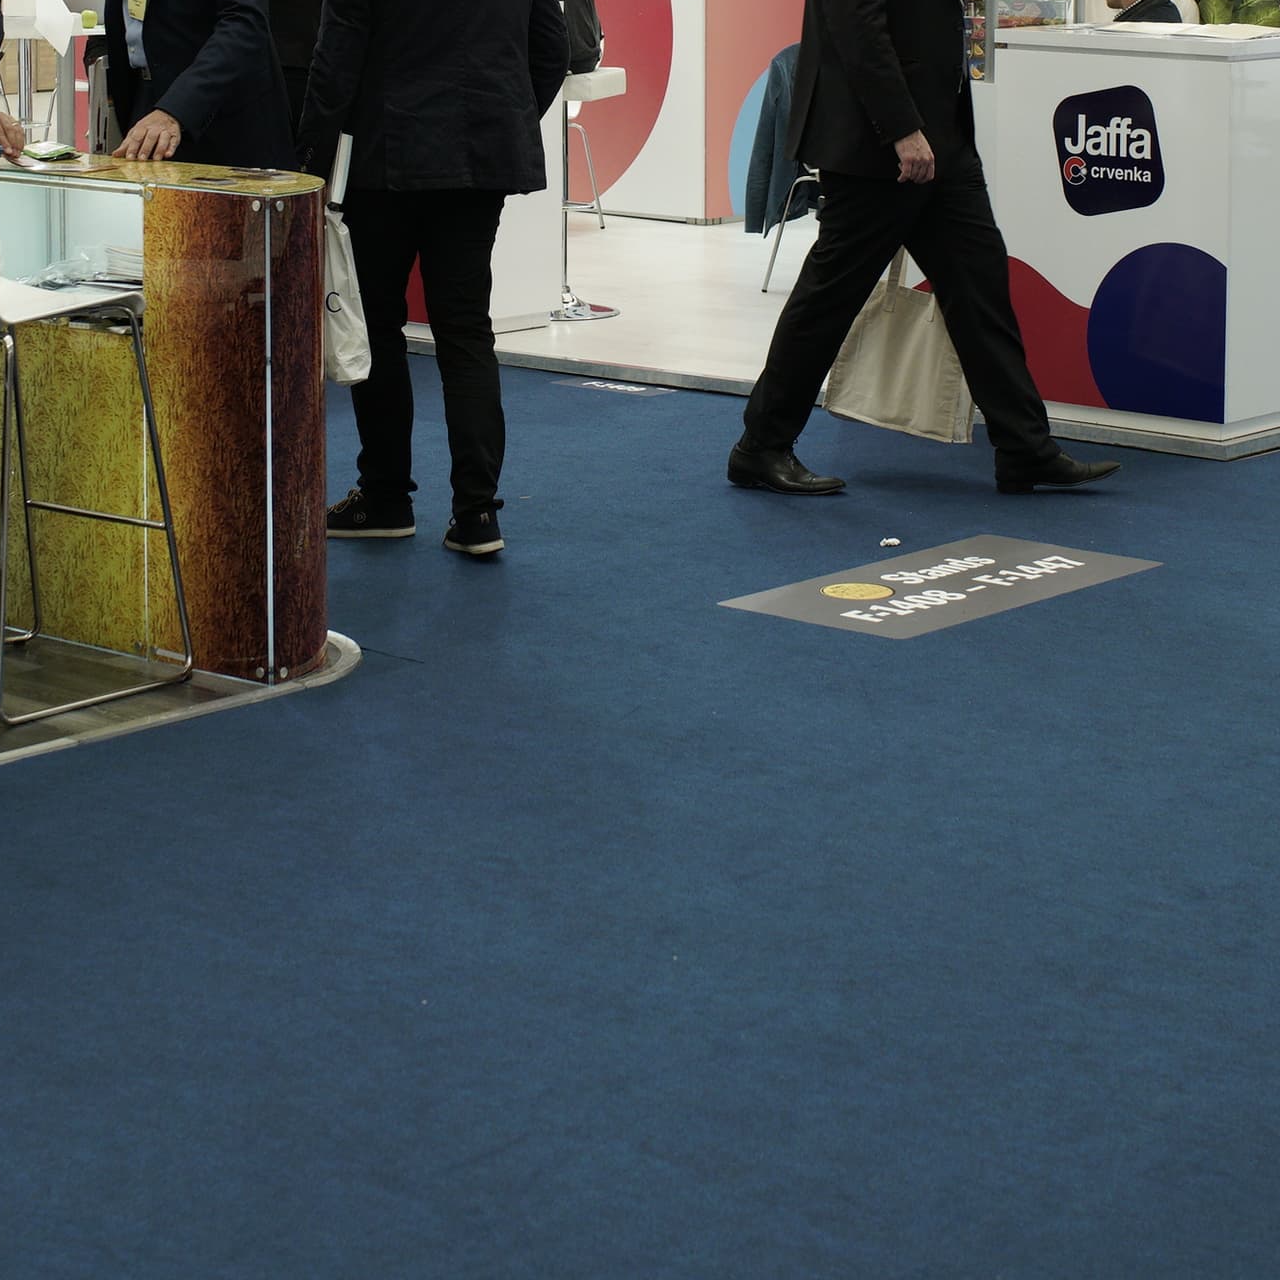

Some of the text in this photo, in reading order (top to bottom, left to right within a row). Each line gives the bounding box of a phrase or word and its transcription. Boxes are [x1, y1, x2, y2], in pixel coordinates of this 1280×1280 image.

[1064, 114, 1152, 159] Jaffa
[1090, 166, 1152, 183] crvenka
[879, 553, 996, 585] Stands
[839, 589, 969, 623] F-1408
[983, 555, 1086, 588] F-1447
